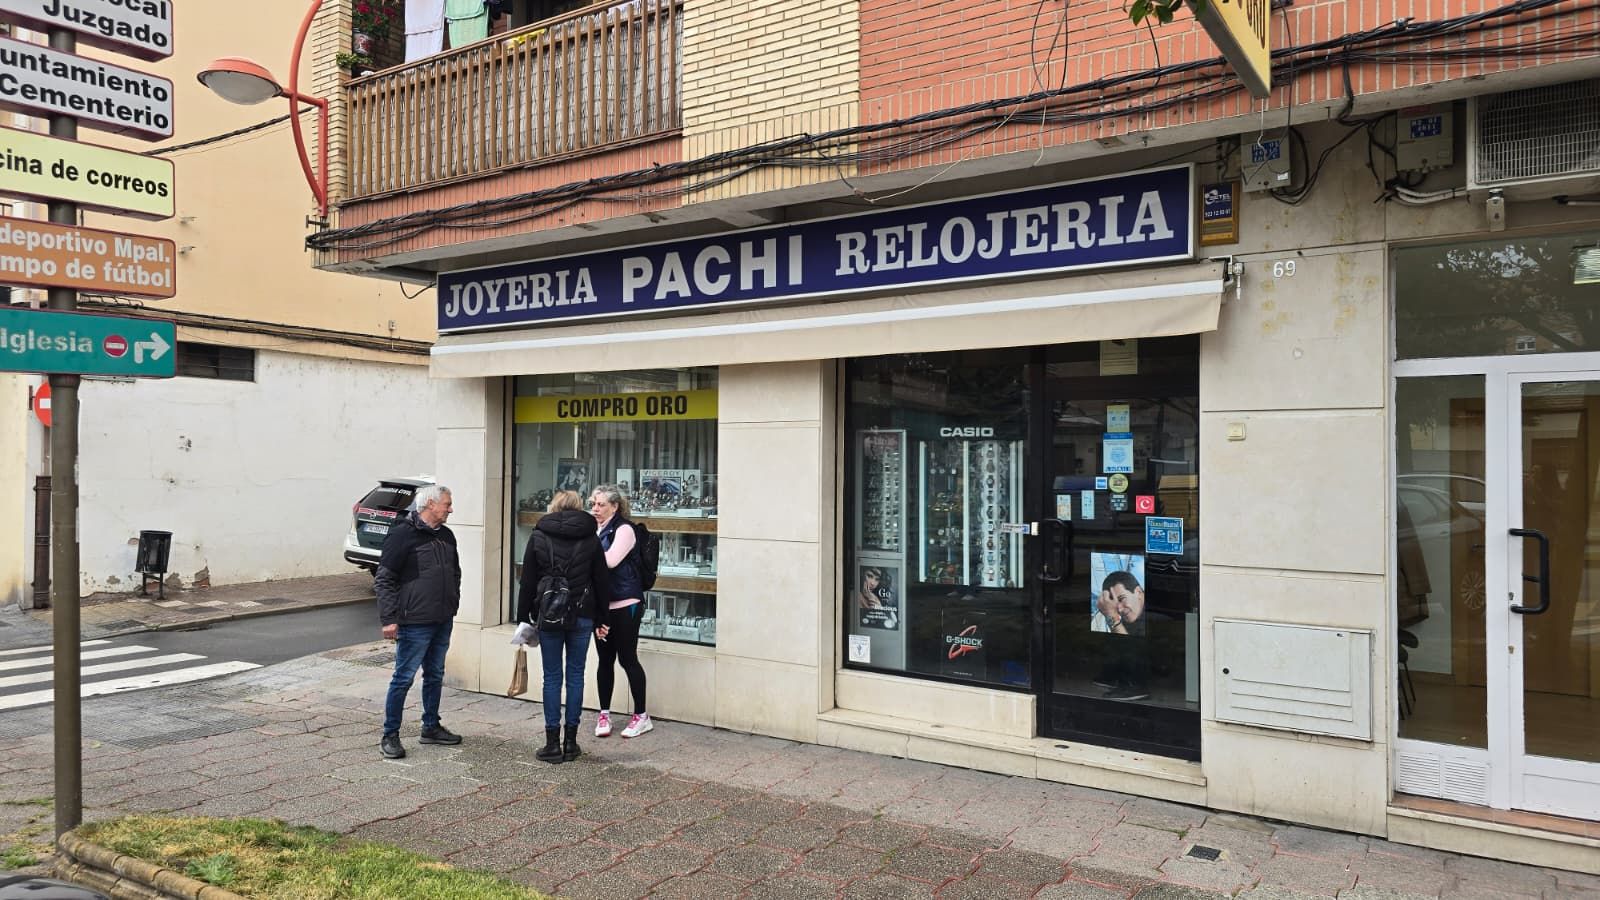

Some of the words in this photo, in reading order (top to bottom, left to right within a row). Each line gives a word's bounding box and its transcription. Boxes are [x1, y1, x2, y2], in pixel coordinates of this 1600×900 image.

[43, 0, 168, 47] Juzgado
[0, 73, 169, 129] Cementerio
[51, 159, 79, 181] de
[86, 169, 168, 197] correos
[0, 222, 107, 255] deportivo
[114, 237, 170, 264] Mpal.
[445, 267, 597, 318] JOYERIA
[622, 235, 803, 303] PACHI
[835, 190, 1174, 277] RELOJERIA
[66, 259, 95, 280] de
[104, 261, 171, 288] fútbol
[1273, 260, 1296, 278] 69
[0, 328, 93, 353] Iglesia
[557, 395, 639, 419] COMPRO
[646, 394, 688, 416] ORO
[940, 427, 994, 438] CASIO
[945, 635, 983, 648] G-SHOCK
